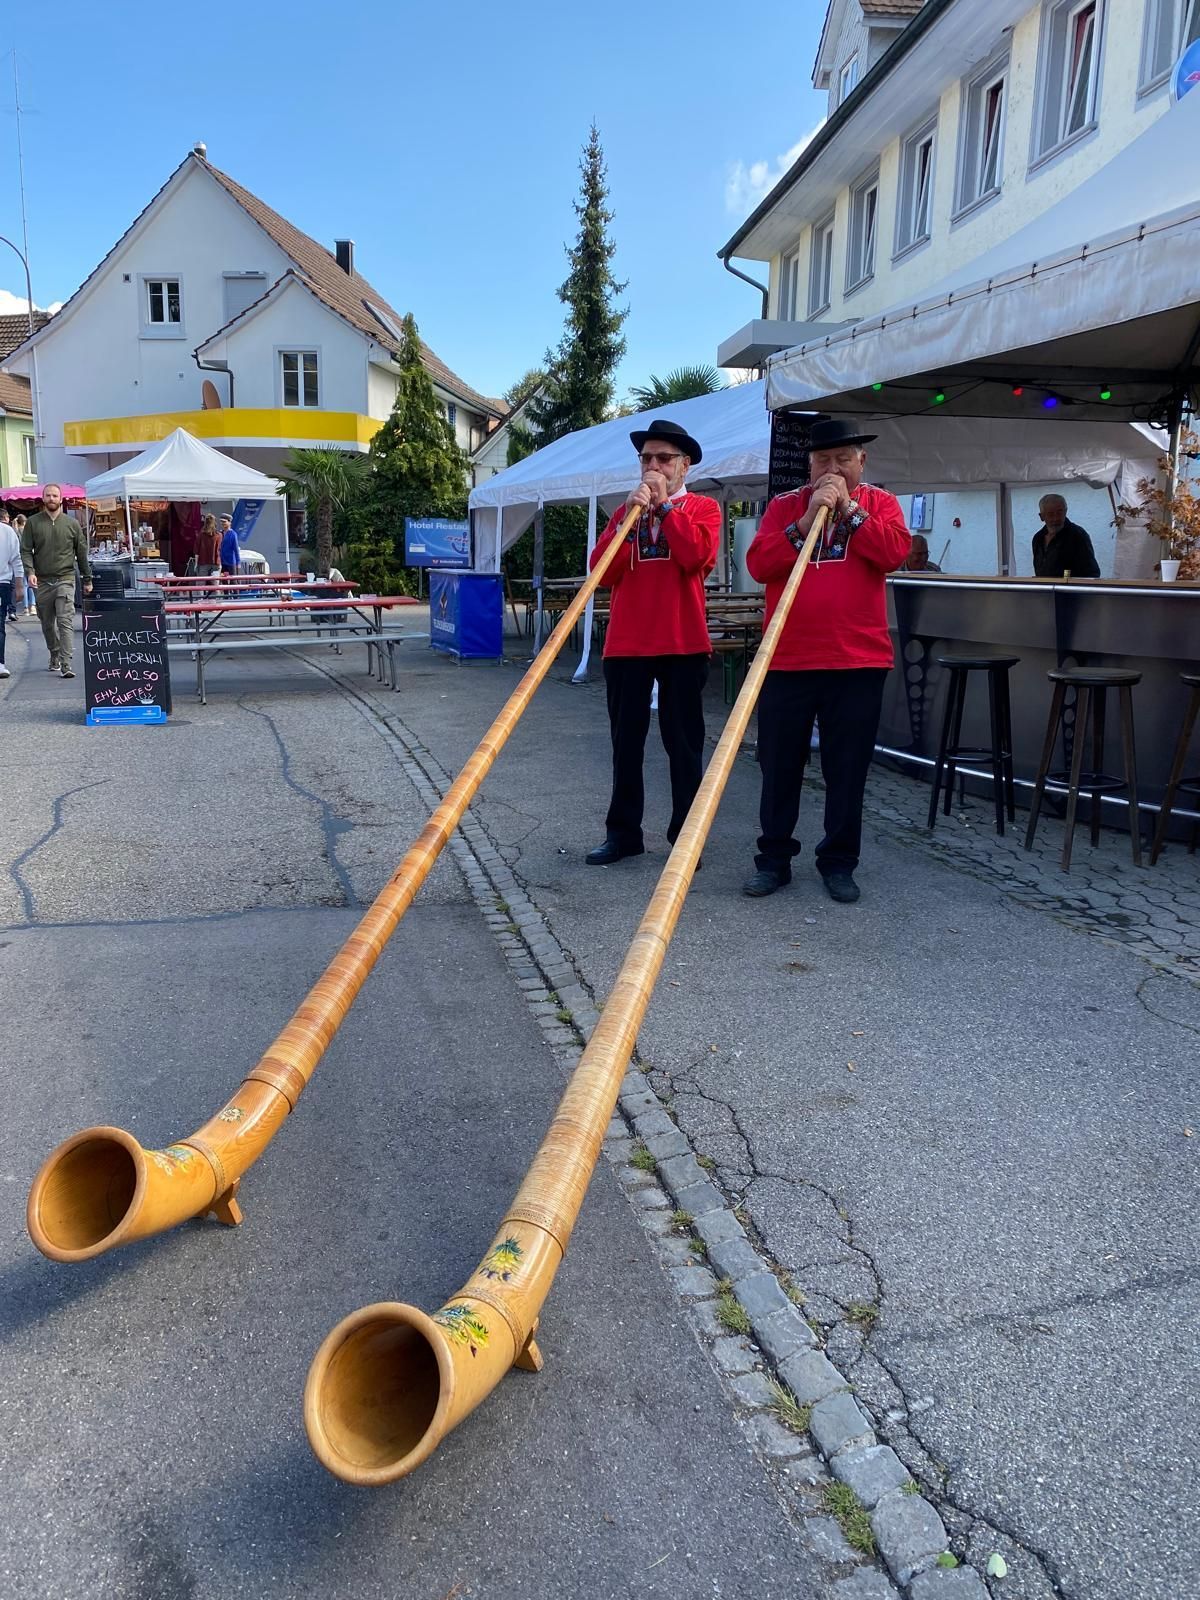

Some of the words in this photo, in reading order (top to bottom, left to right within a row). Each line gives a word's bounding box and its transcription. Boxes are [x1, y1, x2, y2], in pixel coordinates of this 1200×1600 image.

[409, 521, 434, 529] Hotel
[85, 630, 160, 647] GHACKETS
[88, 651, 114, 663] MIT
[96, 668, 121, 680] CHF
[94, 686, 118, 704] EHN
[111, 687, 144, 706] GUETE
